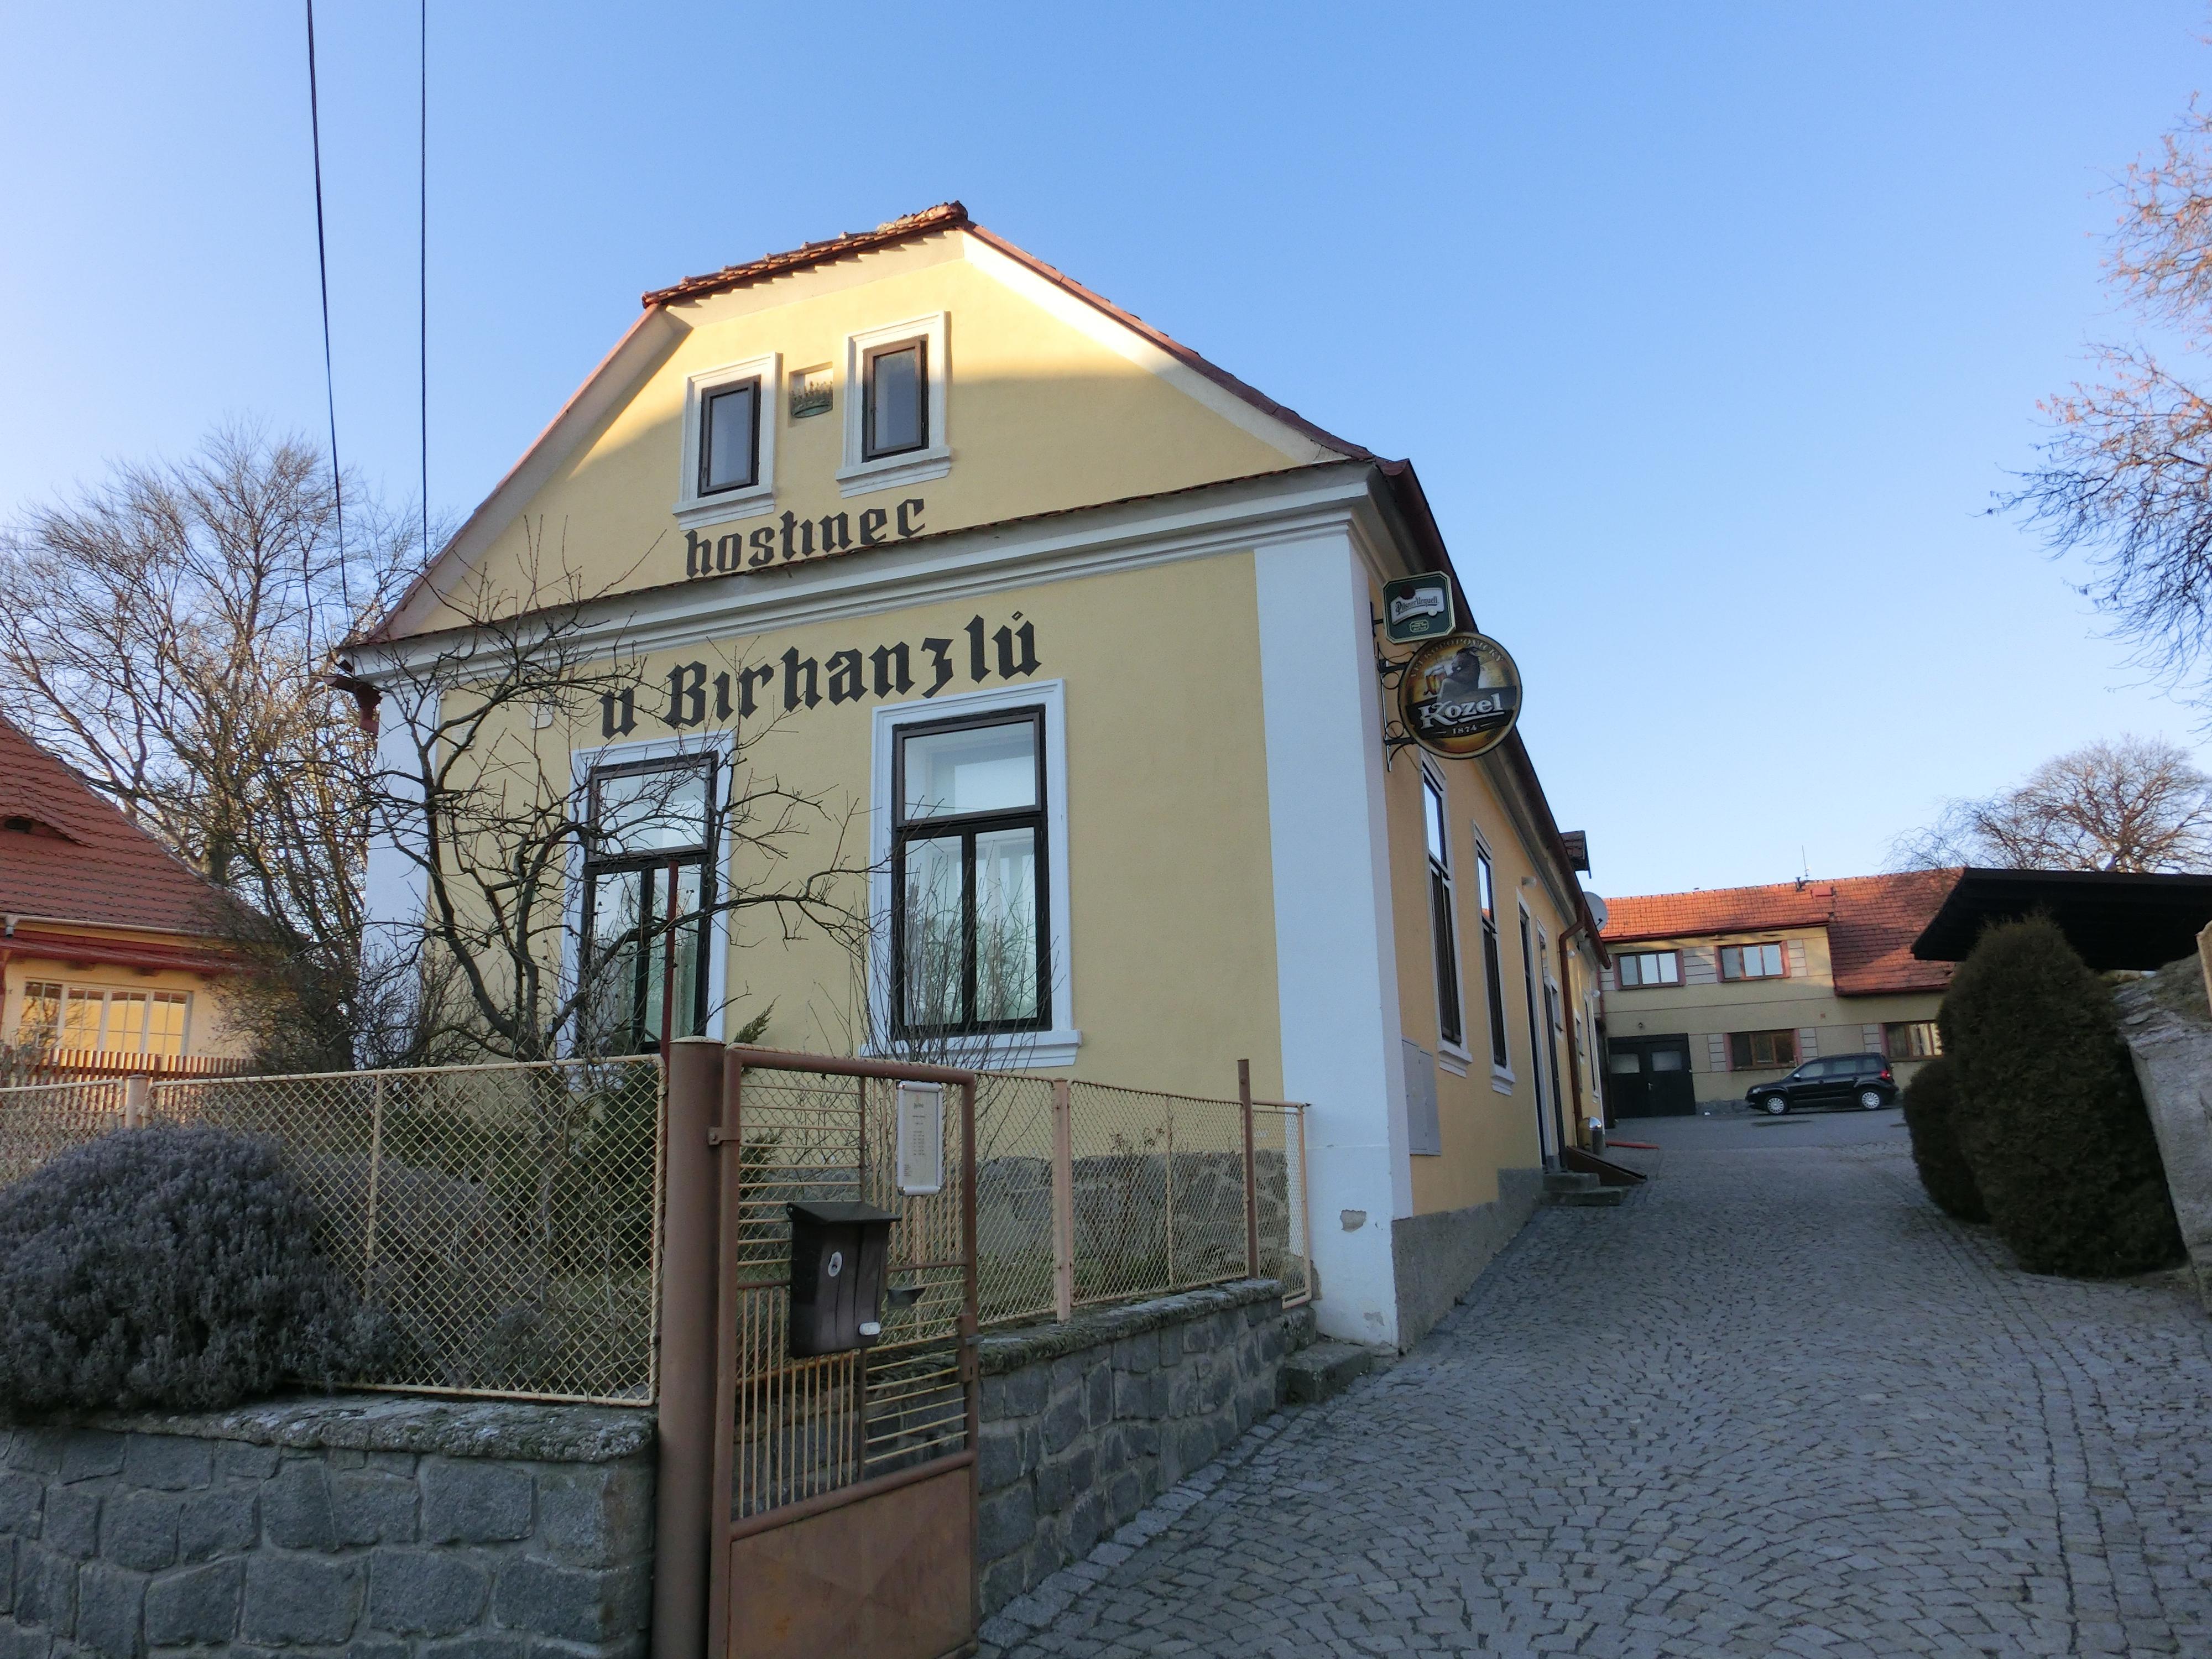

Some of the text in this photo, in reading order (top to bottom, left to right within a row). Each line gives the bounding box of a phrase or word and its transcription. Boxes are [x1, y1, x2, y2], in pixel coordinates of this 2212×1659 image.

[685, 498, 926, 579] hostinec
[1395, 596, 1438, 616] Pilsner Urquell
[598, 611, 1042, 740] u Birhanzlů
[1418, 692, 1504, 729] Kozel
[1452, 724, 1478, 735] 1874
